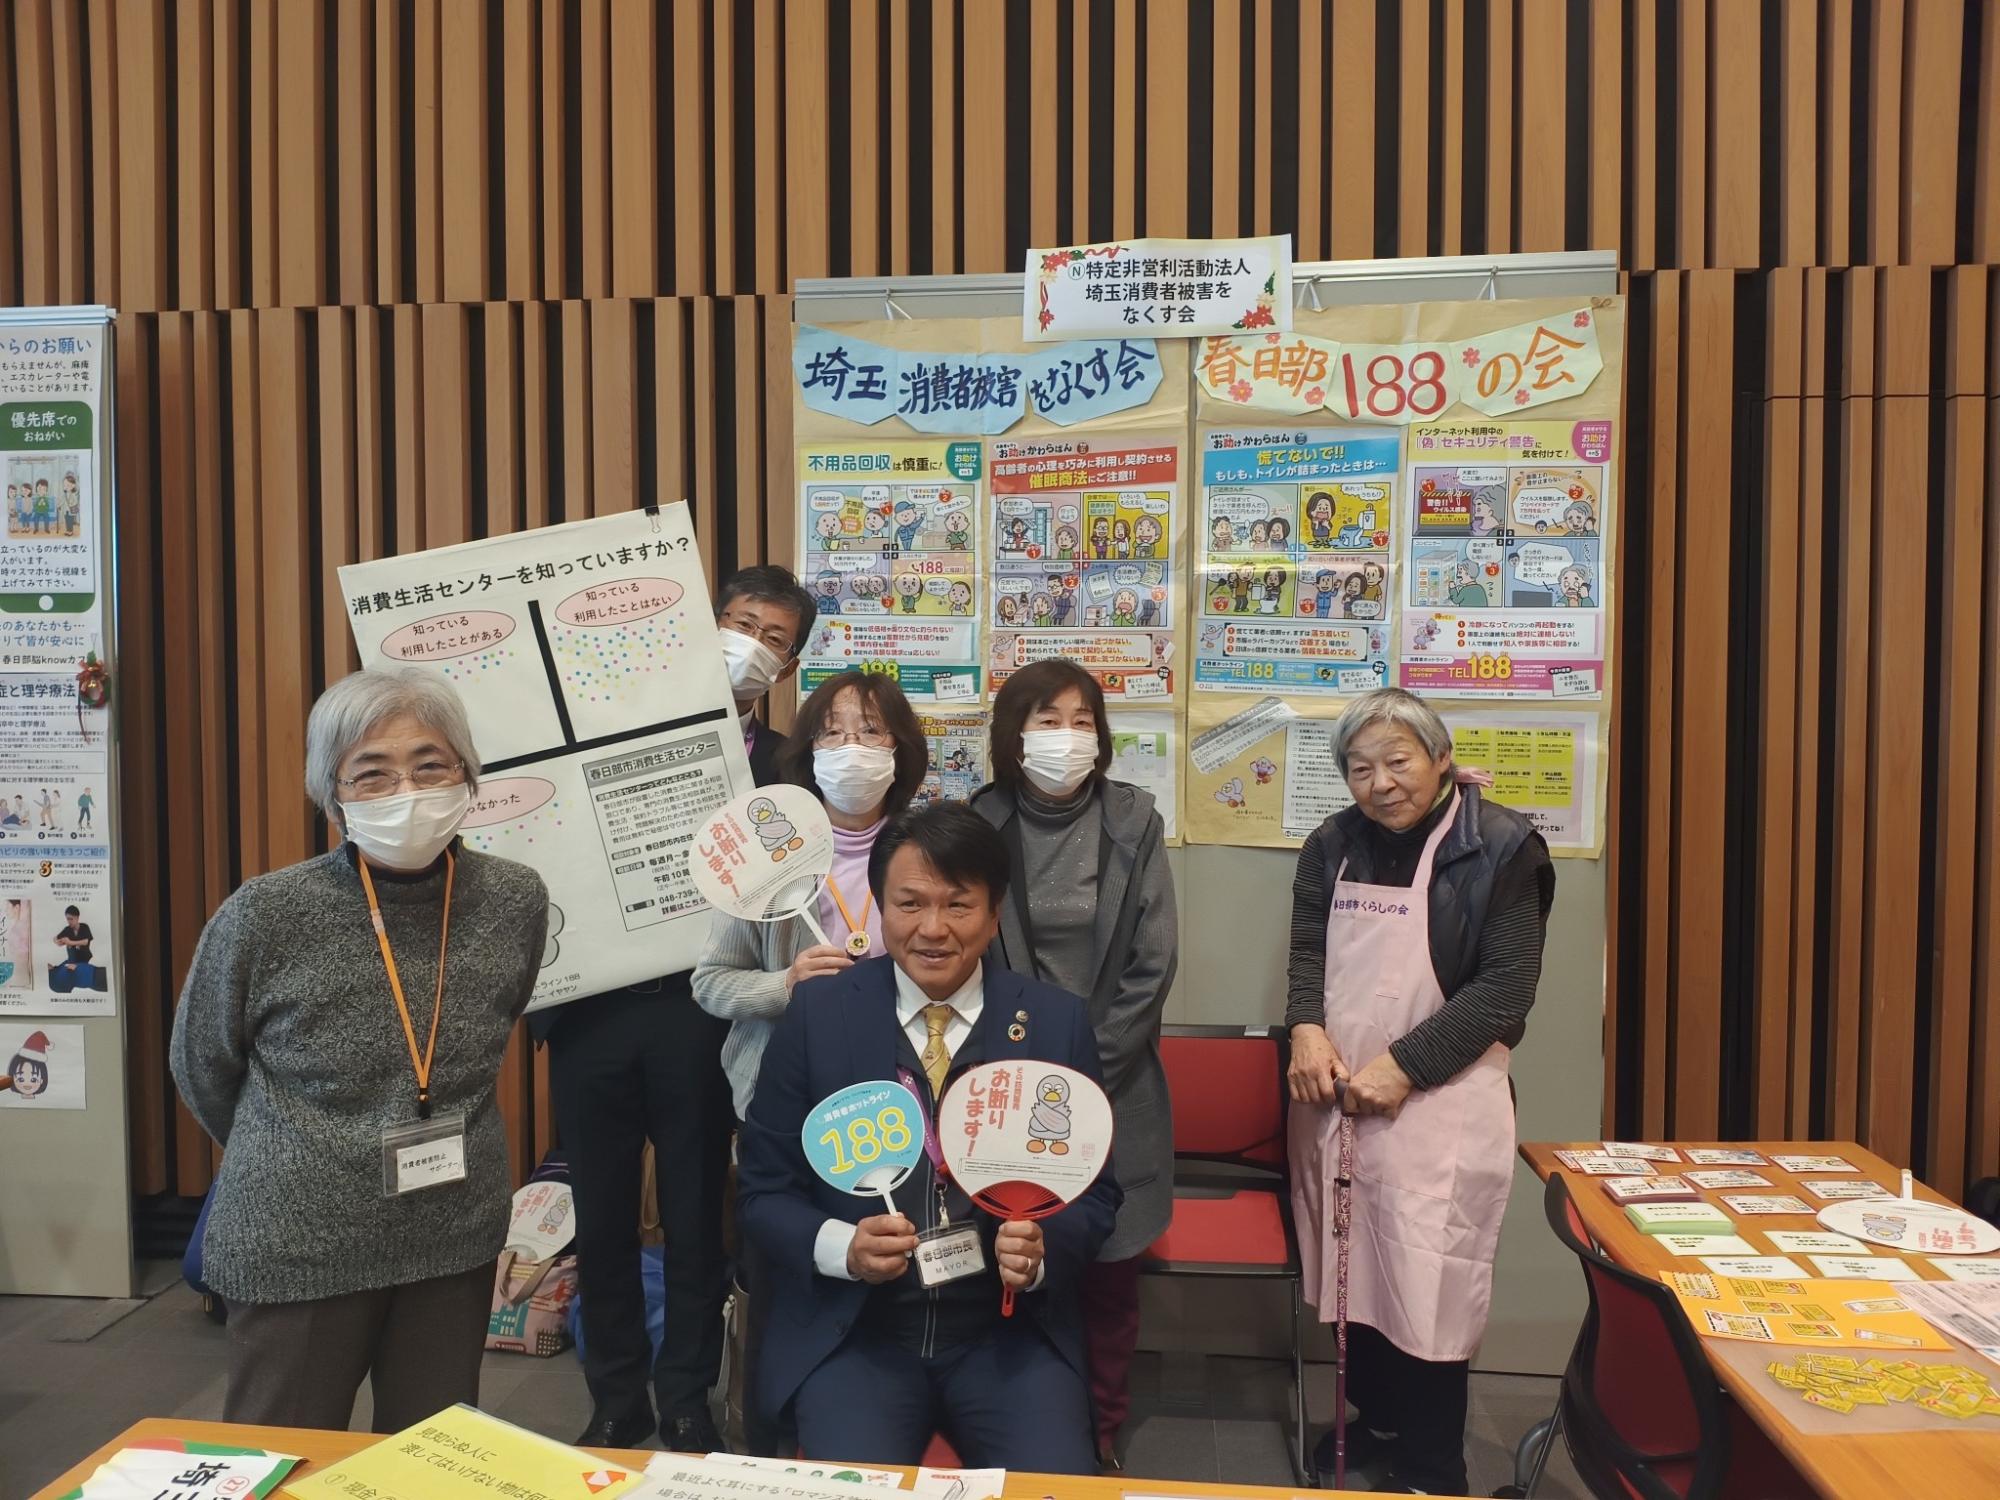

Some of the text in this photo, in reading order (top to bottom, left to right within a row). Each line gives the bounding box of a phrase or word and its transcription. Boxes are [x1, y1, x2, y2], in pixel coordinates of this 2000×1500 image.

[1086, 257, 1251, 280] 特定非営利活動法人
[1085, 281, 1232, 303] 埼玉消費者被害を
[1122, 305, 1196, 324] なくす会
[0, 337, 93, 355] らのお願い
[1, 383, 94, 393] ていることがあります。
[11, 410, 77, 428] 優先席での
[24, 431, 65, 442] おねがい
[808, 454, 943, 472] 不用品回収は慎重に!
[1257, 446, 1344, 466] 慌てないで!!
[1522, 450, 1569, 458] 気を付けて!
[994, 453, 1172, 476] 高齢者の心理を巧みに利用し契約させる
[1215, 461, 1387, 481] もしも、トイレが詰まったときは…
[1029, 470, 1137, 489] 催眠商法にご注意!!
[1, 544, 88, 554] 立っているのが大変な
[1, 556, 48, 566] 人がいます。
[919, 561, 944, 574] 188
[1, 567, 88, 577] 時々スマホから視線を
[351, 537, 690, 616] 消費生活センターを知っていますか？
[1, 578, 76, 588] 上げてみて下さい。
[585, 582, 640, 602] 知っている
[574, 594, 673, 623] 利用したことはない
[0, 620, 85, 632] のあなたかも…
[413, 616, 470, 636] 知っている
[0, 635, 85, 647] りで皆が安心に
[401, 627, 503, 658] 利用したことがある
[1246, 662, 1274, 679] 188
[1448, 668, 1469, 678] TEL
[1466, 654, 1513, 680] 188
[590, 743, 717, 780] 春日部市消費生活センター
[709, 822, 747, 867] お断り
[823, 1090, 891, 1122] 消費者ホットライン
[988, 1068, 1011, 1130] お断り
[964, 1077, 986, 1157] します!
[820, 1106, 912, 1174] 188
[922, 1239, 974, 1263] 春日部市長
[935, 1259, 969, 1274] MAYOR
[415, 1427, 497, 1463] 見知らぬ人に
[671, 1472, 872, 1500] 最近よく耳にする「ロマンス
